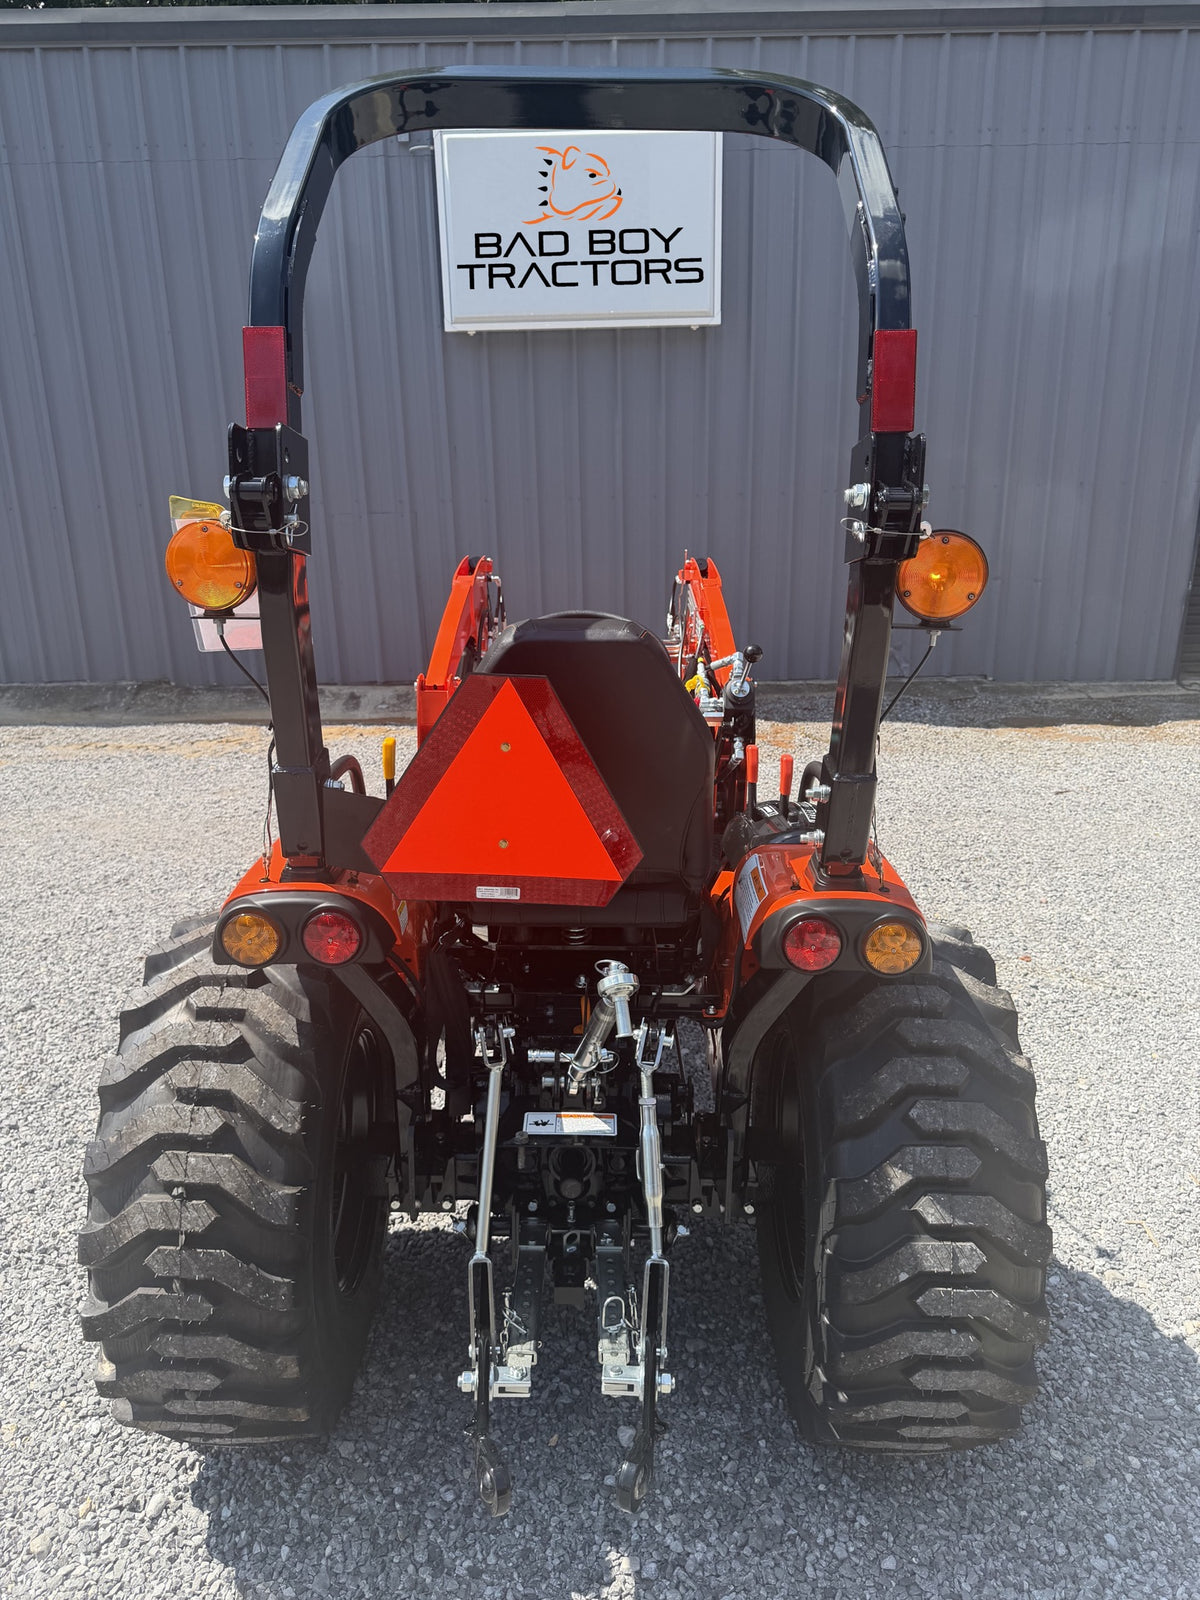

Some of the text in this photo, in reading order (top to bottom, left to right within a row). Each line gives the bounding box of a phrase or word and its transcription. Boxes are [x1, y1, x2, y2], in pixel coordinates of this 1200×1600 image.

[474, 227, 684, 258] BAD BOY
[457, 258, 704, 289] TRACTORS
